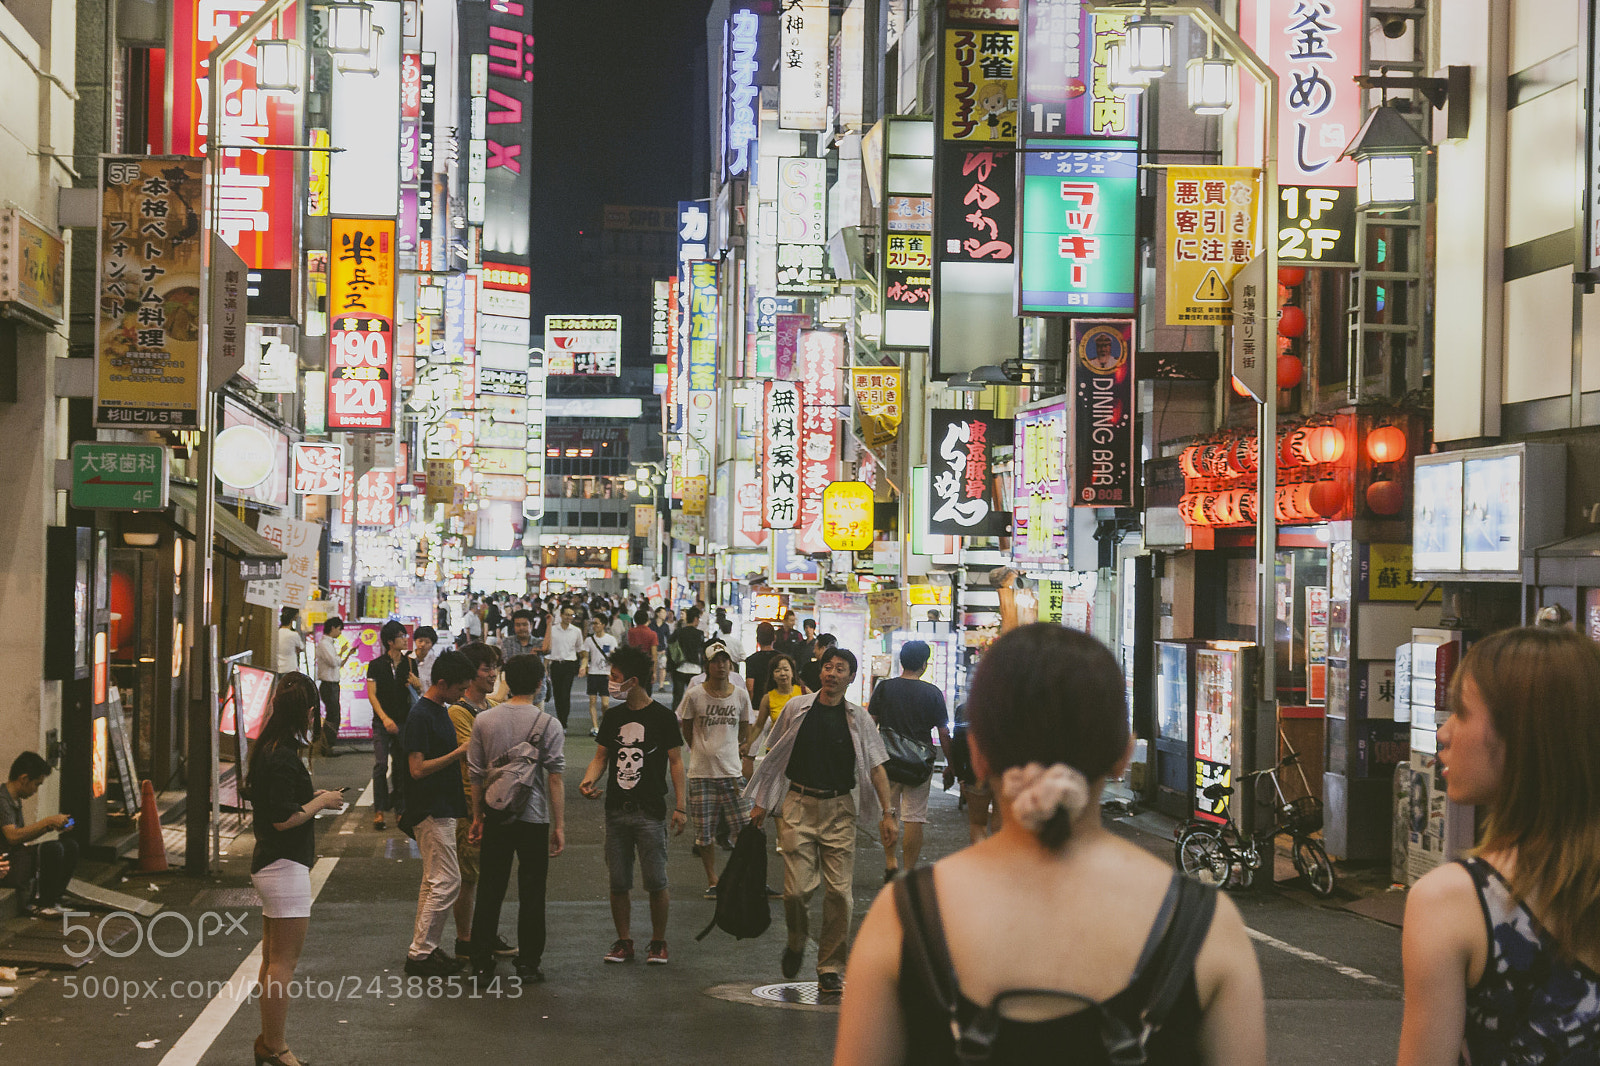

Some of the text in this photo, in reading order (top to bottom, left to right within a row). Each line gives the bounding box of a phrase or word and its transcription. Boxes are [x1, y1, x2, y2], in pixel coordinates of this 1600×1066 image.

[980, 33, 1015, 80] 麻雀
[1288, 0, 1338, 174] 釜めし
[1030, 103, 1062, 133] 1F
[108, 163, 141, 184] 5F
[1056, 162, 1105, 174] カフェ
[1175, 180, 1252, 206] 悪質な
[1059, 181, 1100, 288] ラッキー
[1175, 209, 1251, 236] 客引き
[889, 238, 924, 251] 麻雀
[1175, 238, 1252, 264] に注意
[1277, 228, 1342, 260] 2F
[106, 220, 130, 320] フォンベト
[137, 177, 169, 349] 本格ベトナム料理
[1067, 292, 1090, 306] B1
[1242, 284, 1257, 369] 劇場通り一番街
[856, 375, 896, 388] 悪質な
[1092, 377, 1114, 485] DINING BAR
[80, 451, 157, 474] 大塚歯科
[772, 387, 796, 521] 無料案内所
[965, 419, 988, 500] 東京豚骨
[132, 490, 153, 503] 4F
[705, 704, 736, 717] Walk
